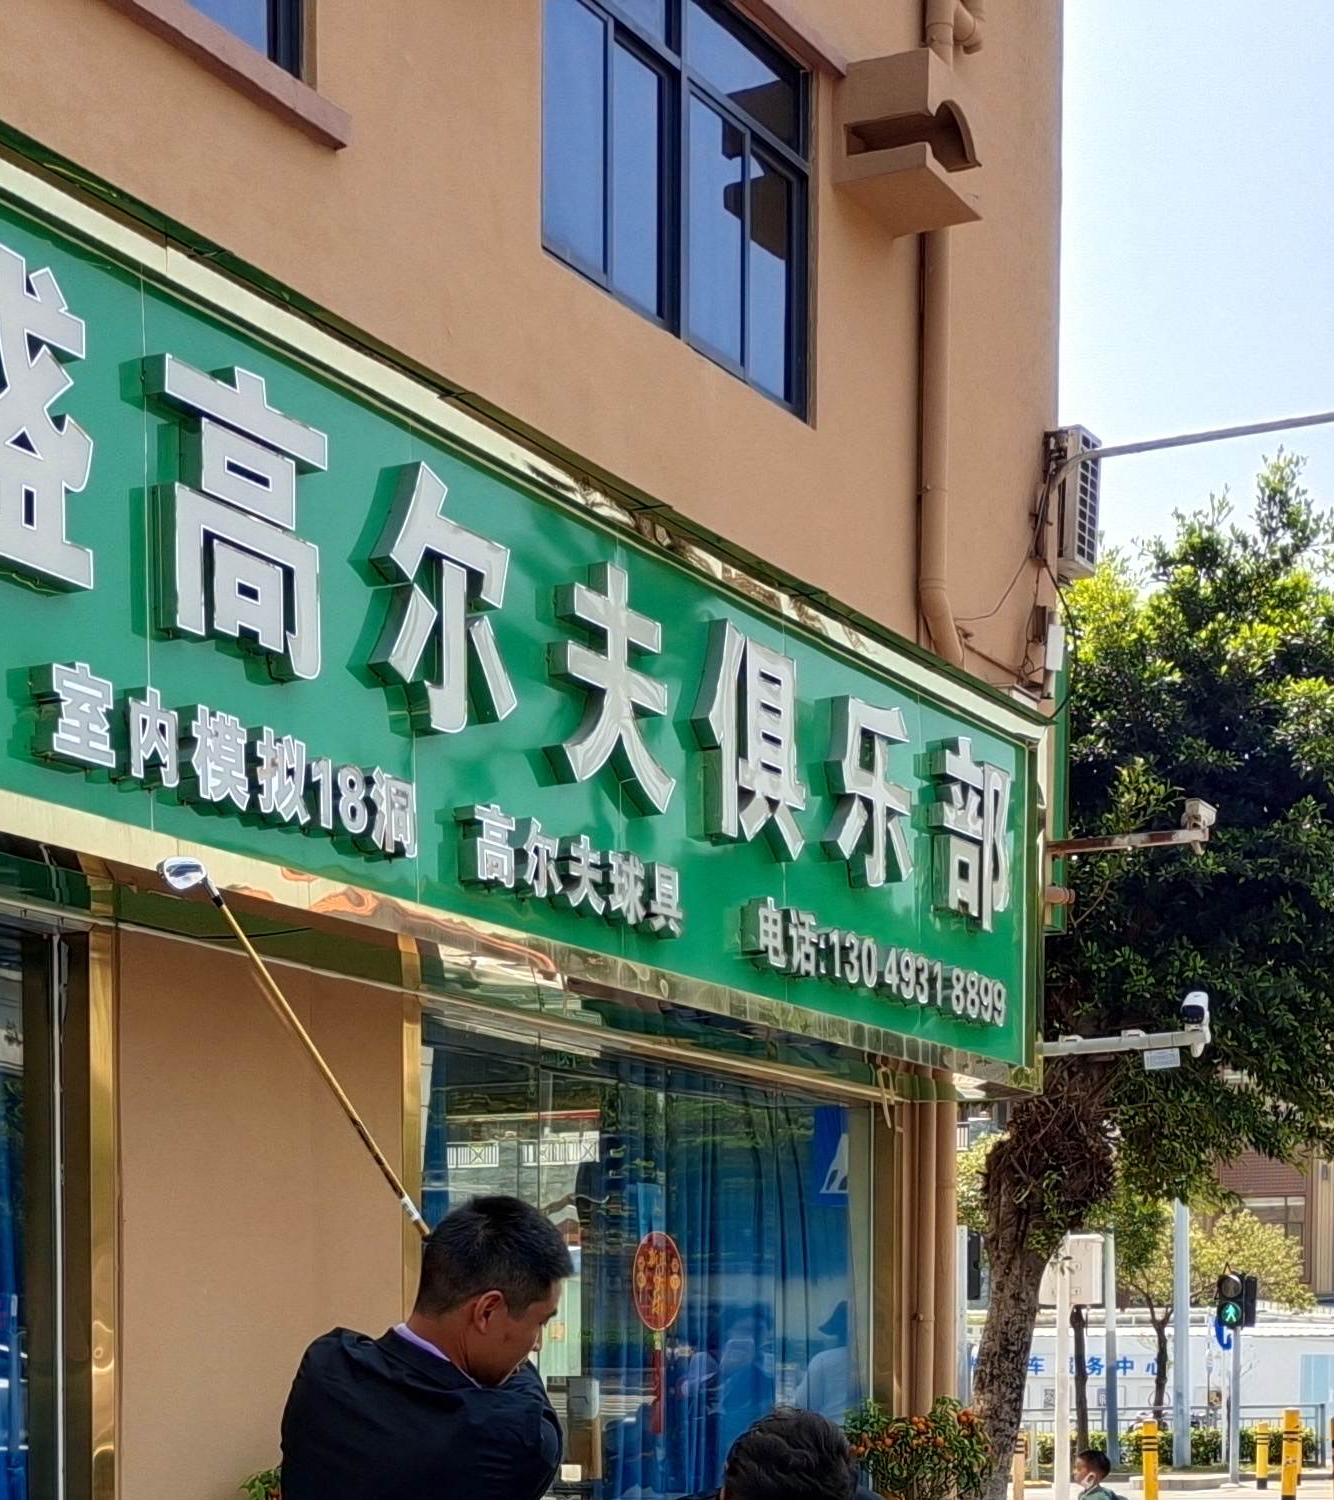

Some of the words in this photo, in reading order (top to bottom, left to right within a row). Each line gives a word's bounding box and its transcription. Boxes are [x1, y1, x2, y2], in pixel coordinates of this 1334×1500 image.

[53, 662, 418, 858] 室内模拟18洞
[475, 804, 683, 938] 高尔夫球具
